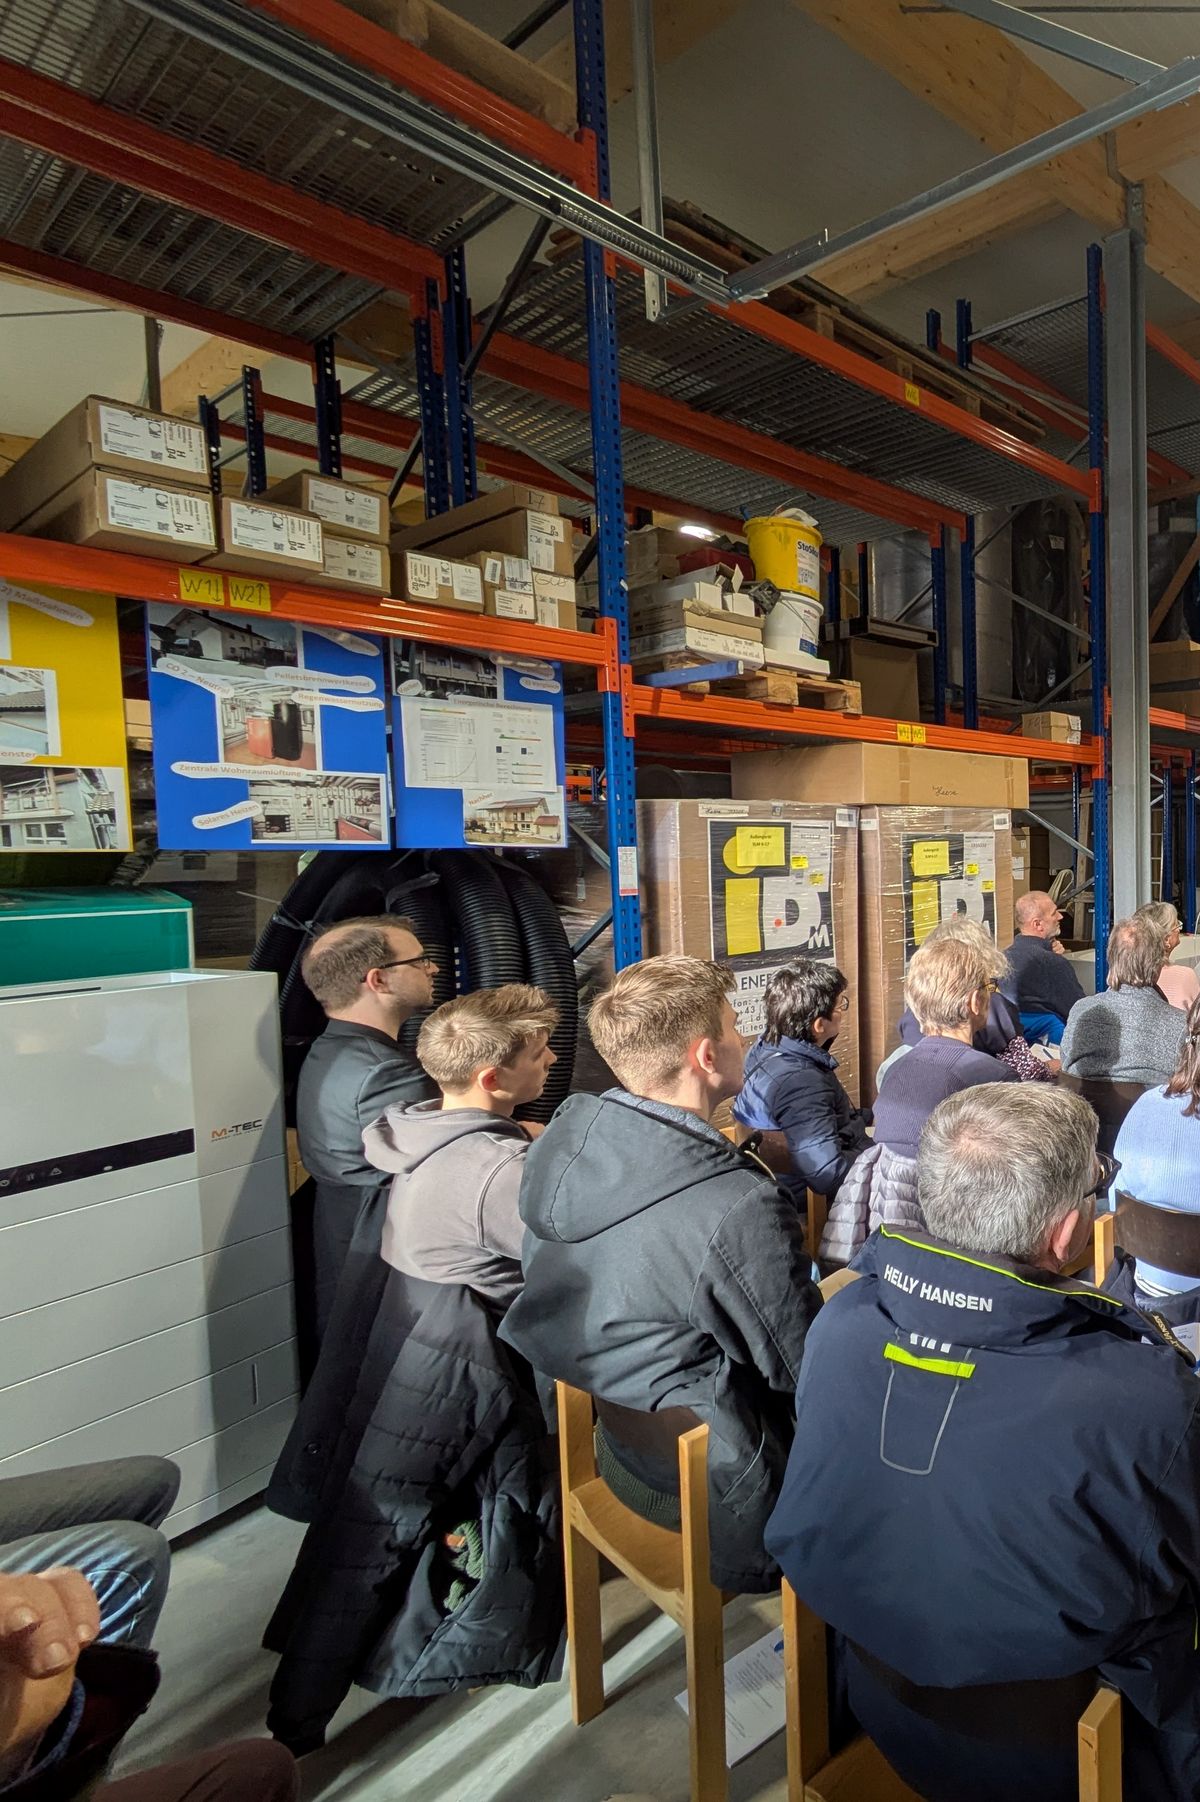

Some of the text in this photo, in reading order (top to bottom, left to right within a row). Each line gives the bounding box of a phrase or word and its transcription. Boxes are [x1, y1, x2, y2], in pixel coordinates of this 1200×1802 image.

[181, 573, 211, 595] W1
[231, 581, 255, 603] W2
[196, 675, 231, 696] Neutral
[0, 750, 37, 760] enster
[179, 764, 218, 773] Zentrale
[211, 1119, 263, 1139] M-TEC
[883, 1263, 993, 1312] HELLY HANSEN
